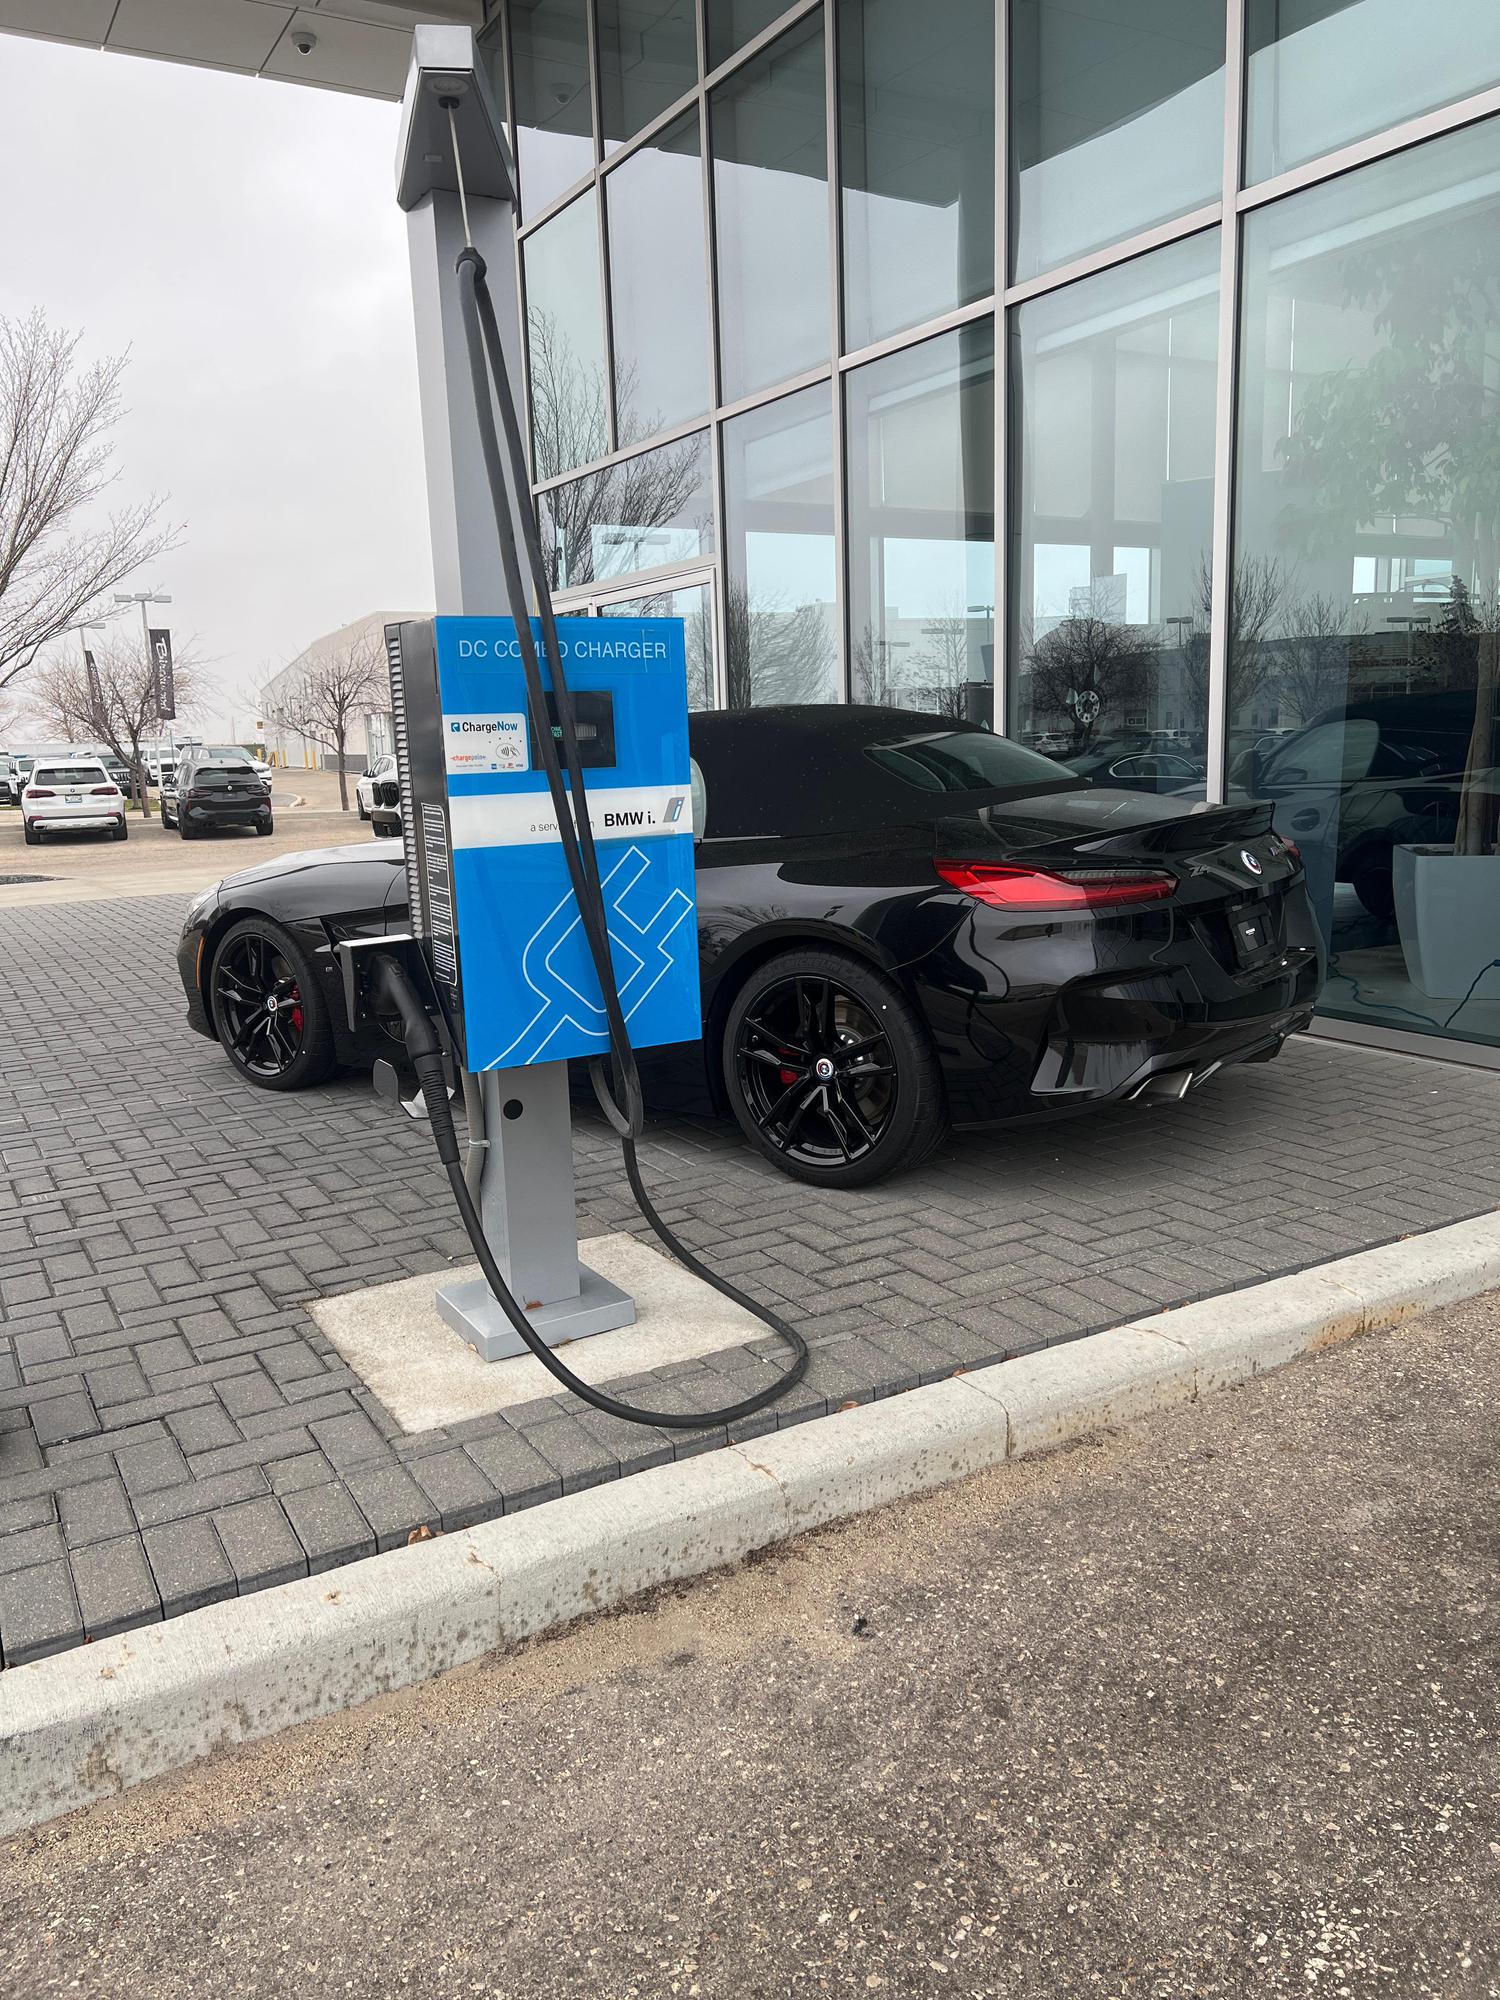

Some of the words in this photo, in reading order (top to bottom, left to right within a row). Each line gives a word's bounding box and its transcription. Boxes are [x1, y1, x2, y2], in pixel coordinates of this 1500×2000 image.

[459, 640, 488, 658] DC
[574, 641, 666, 659] CHARGER
[462, 721, 518, 734] ChargeNow
[604, 811, 644, 827] BMW
[530, 824, 536, 832] a
